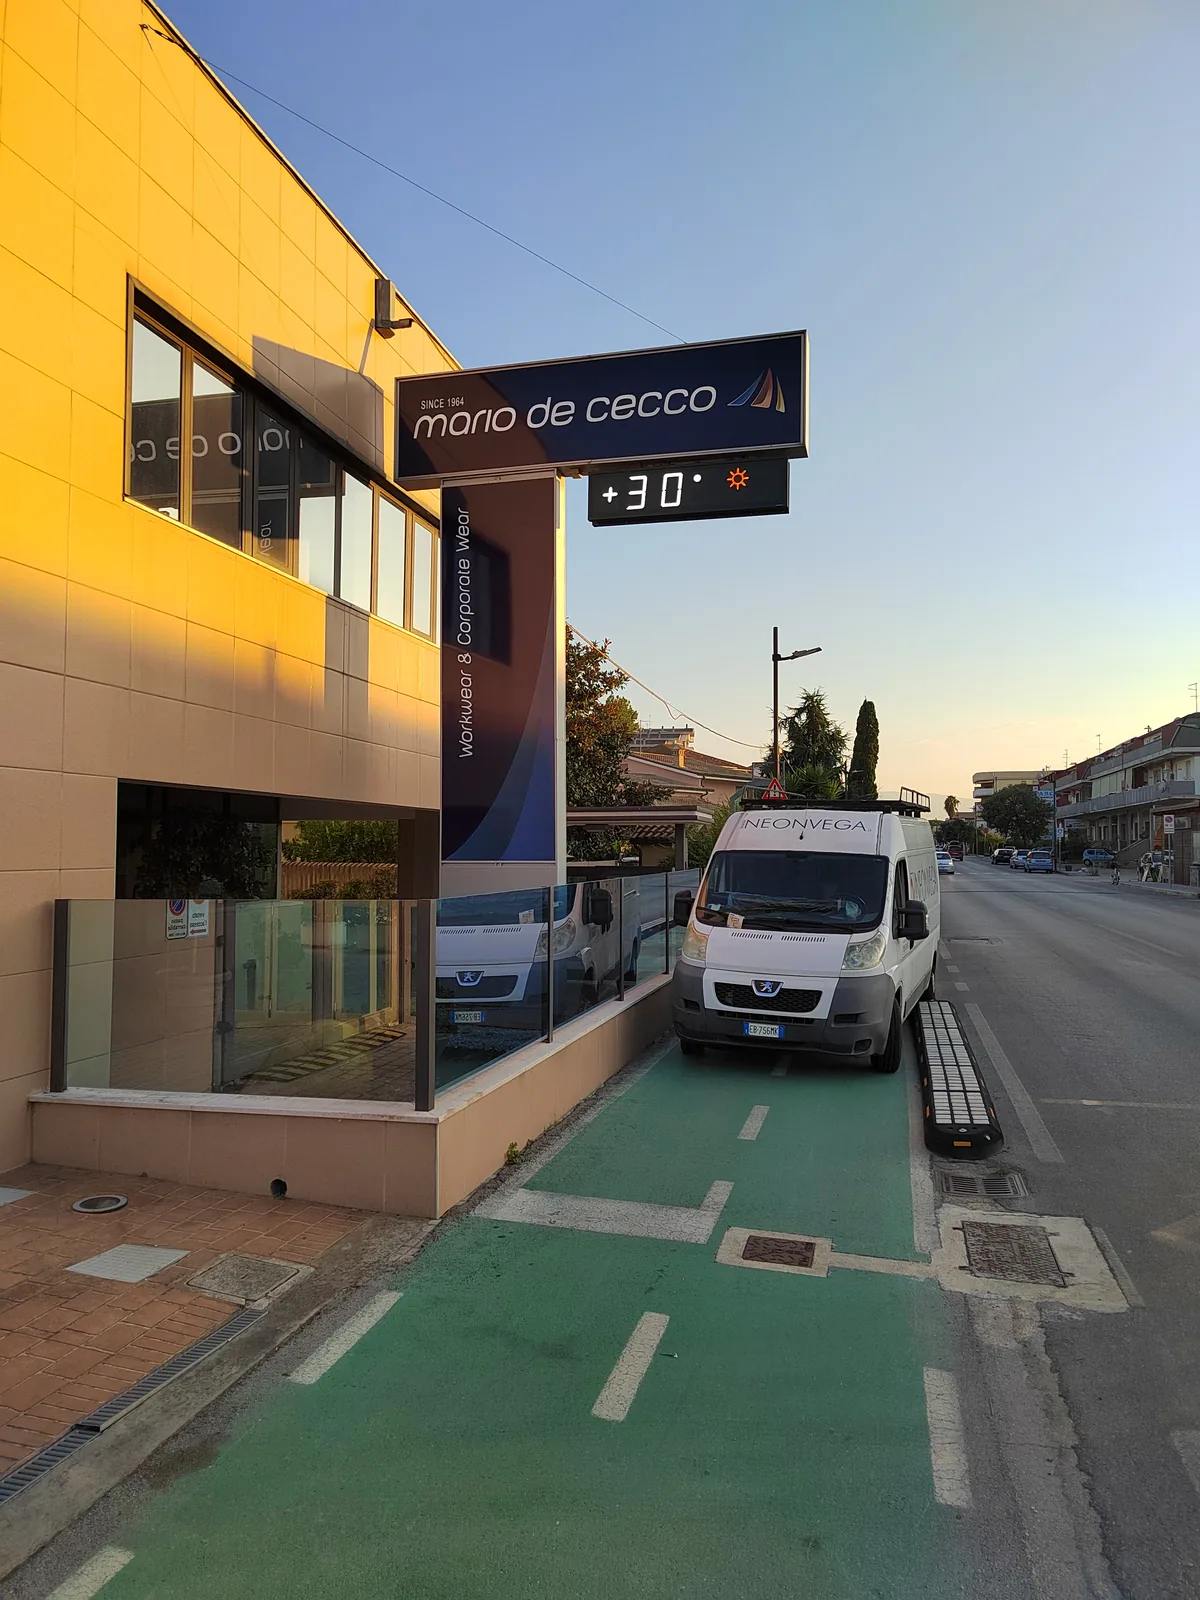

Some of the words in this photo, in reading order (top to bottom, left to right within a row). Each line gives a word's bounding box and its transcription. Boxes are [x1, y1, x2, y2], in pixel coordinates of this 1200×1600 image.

[413, 406, 517, 440] mario
[526, 397, 576, 429] de
[585, 385, 718, 423] cecco
[420, 398, 445, 410] SINCE
[447, 396, 465, 408] 1964
[456, 507, 471, 553] Wear
[457, 558, 475, 647] Corporate
[457, 652, 473, 665] &
[458, 669, 473, 759] Workwear
[744, 818, 867, 832] NEONVEGA
